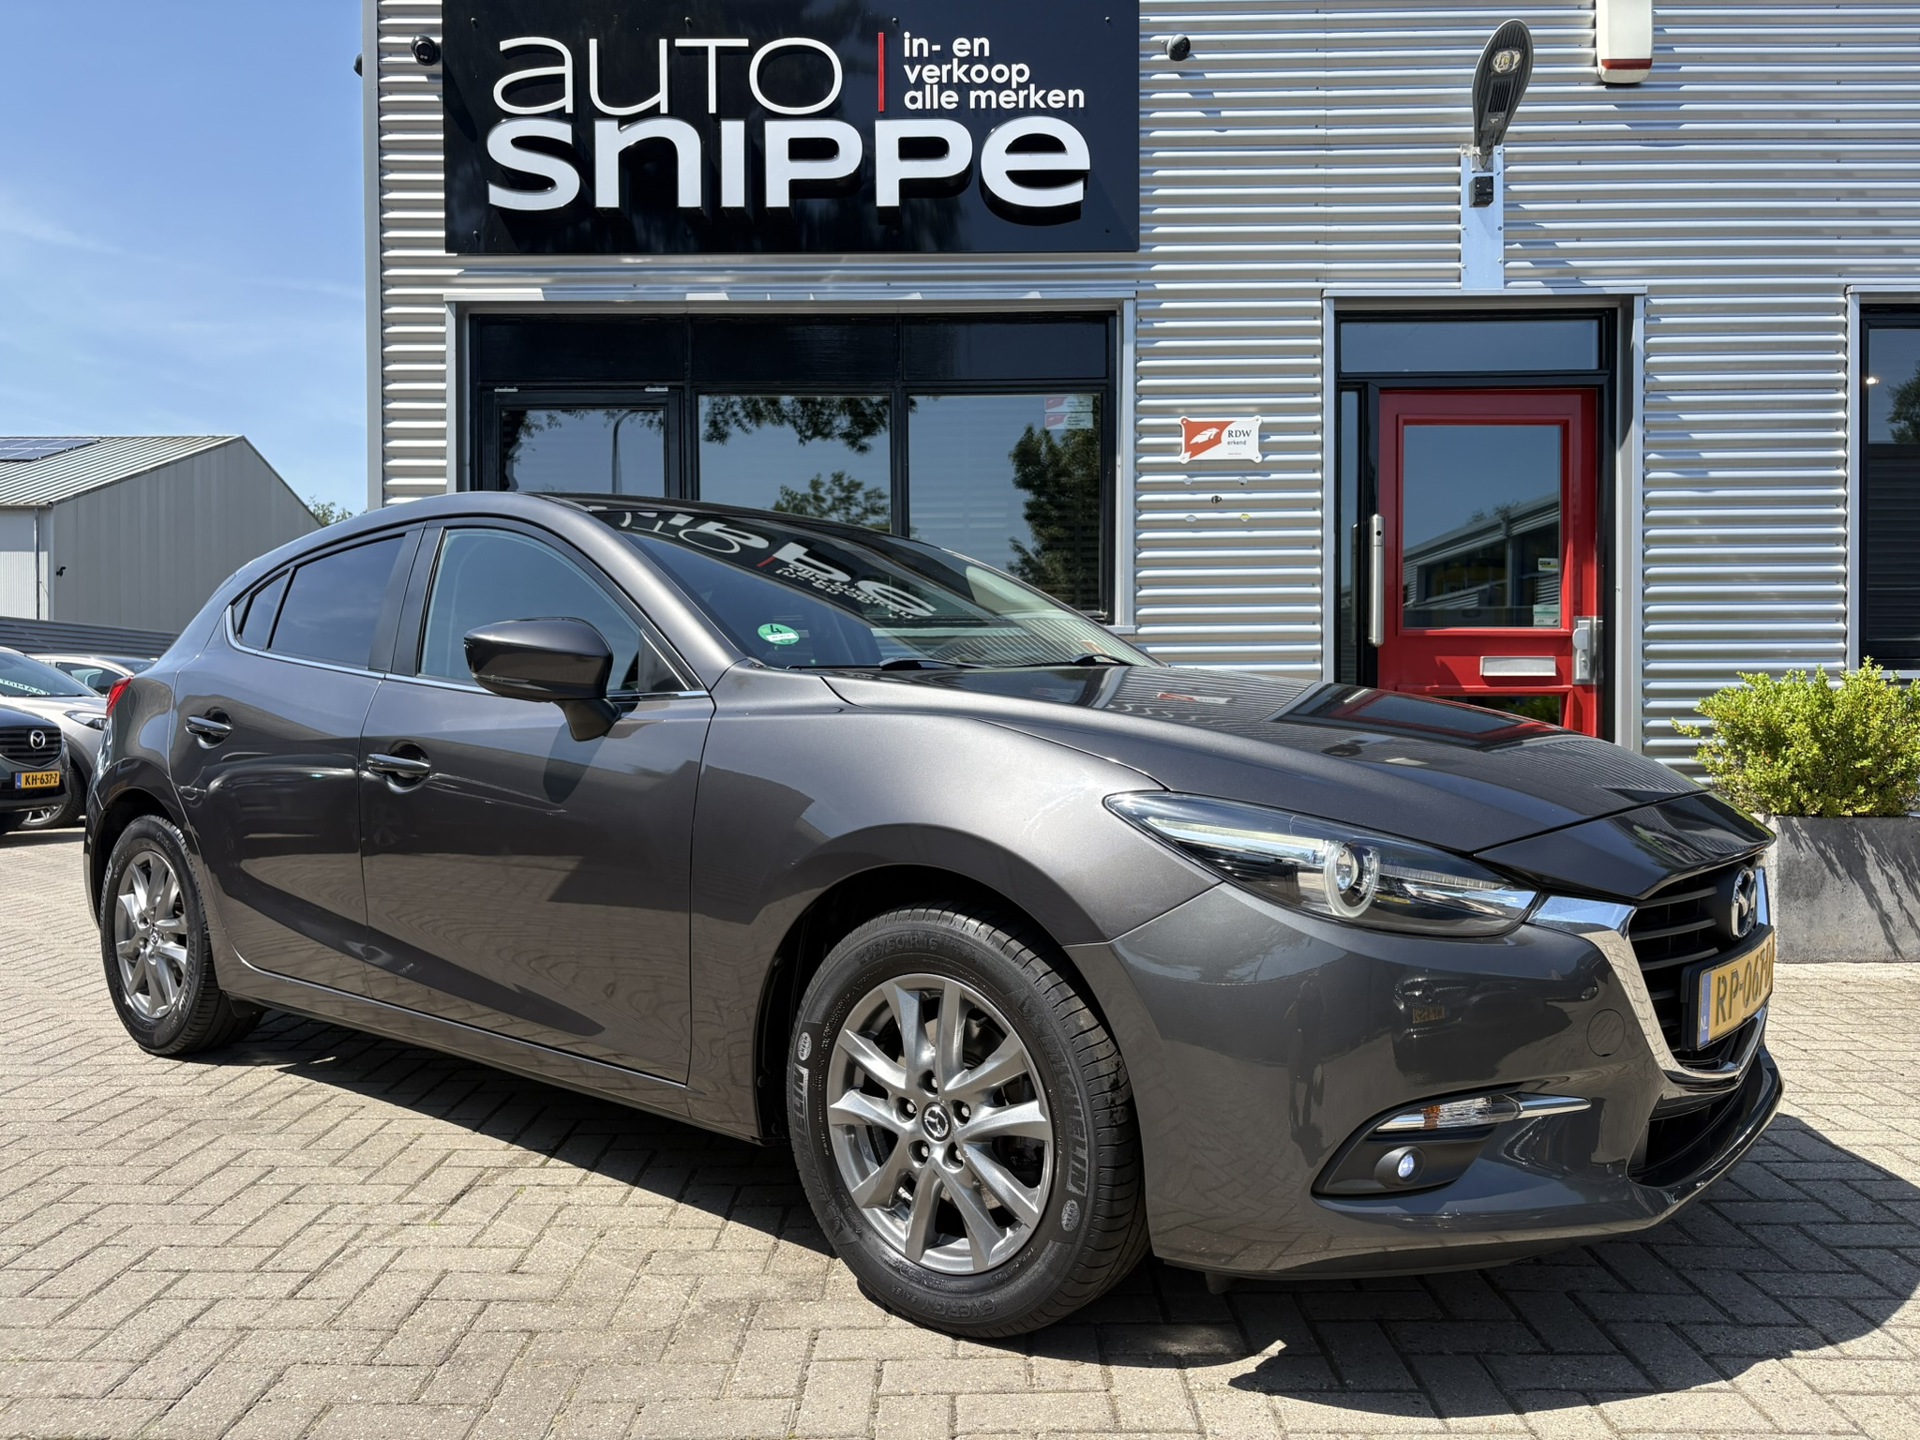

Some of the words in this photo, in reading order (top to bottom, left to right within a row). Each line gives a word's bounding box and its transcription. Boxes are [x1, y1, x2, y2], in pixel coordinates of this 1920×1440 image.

[903, 31, 942, 58] in-
[952, 37, 990, 58] en
[903, 58, 1031, 90] verkoop
[903, 84, 960, 110] alle
[969, 83, 1086, 110] merken
[1227, 429, 1252, 438] RDW
[770, 624, 783, 634] 4
[25, 772, 58, 786] KH-637-Z
